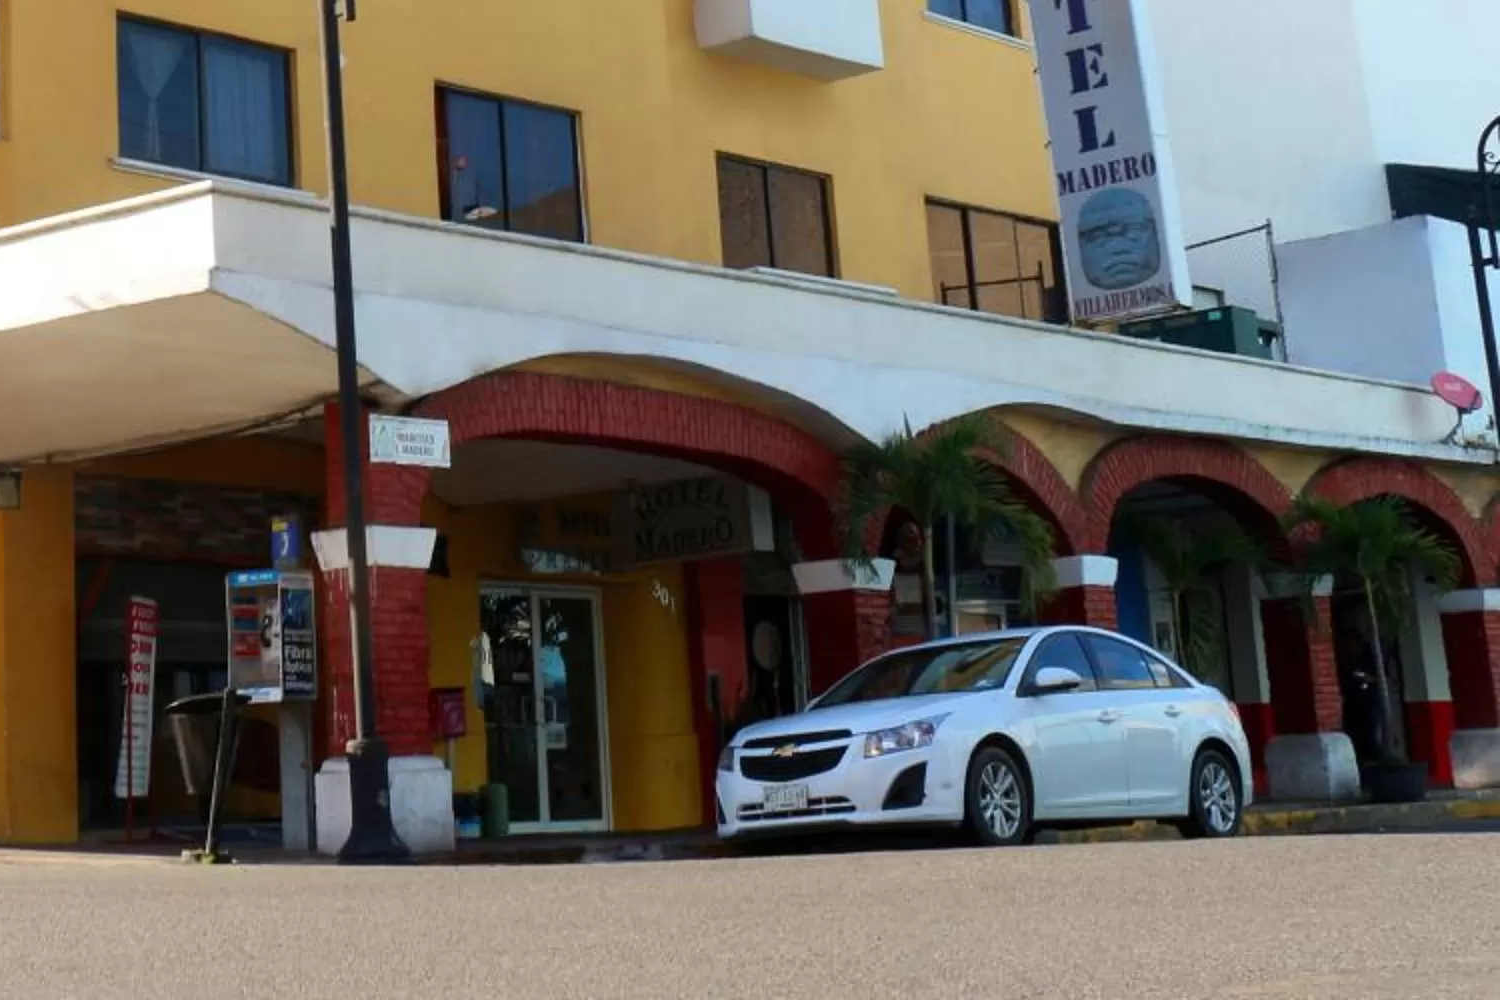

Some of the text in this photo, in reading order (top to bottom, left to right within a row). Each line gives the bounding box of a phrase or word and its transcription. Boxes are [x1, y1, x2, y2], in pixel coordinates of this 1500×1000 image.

[1057, 152, 1158, 196] MADERO
[629, 479, 729, 520] HOTEL
[635, 516, 733, 553] MADERO
[652, 579, 676, 611] 301
